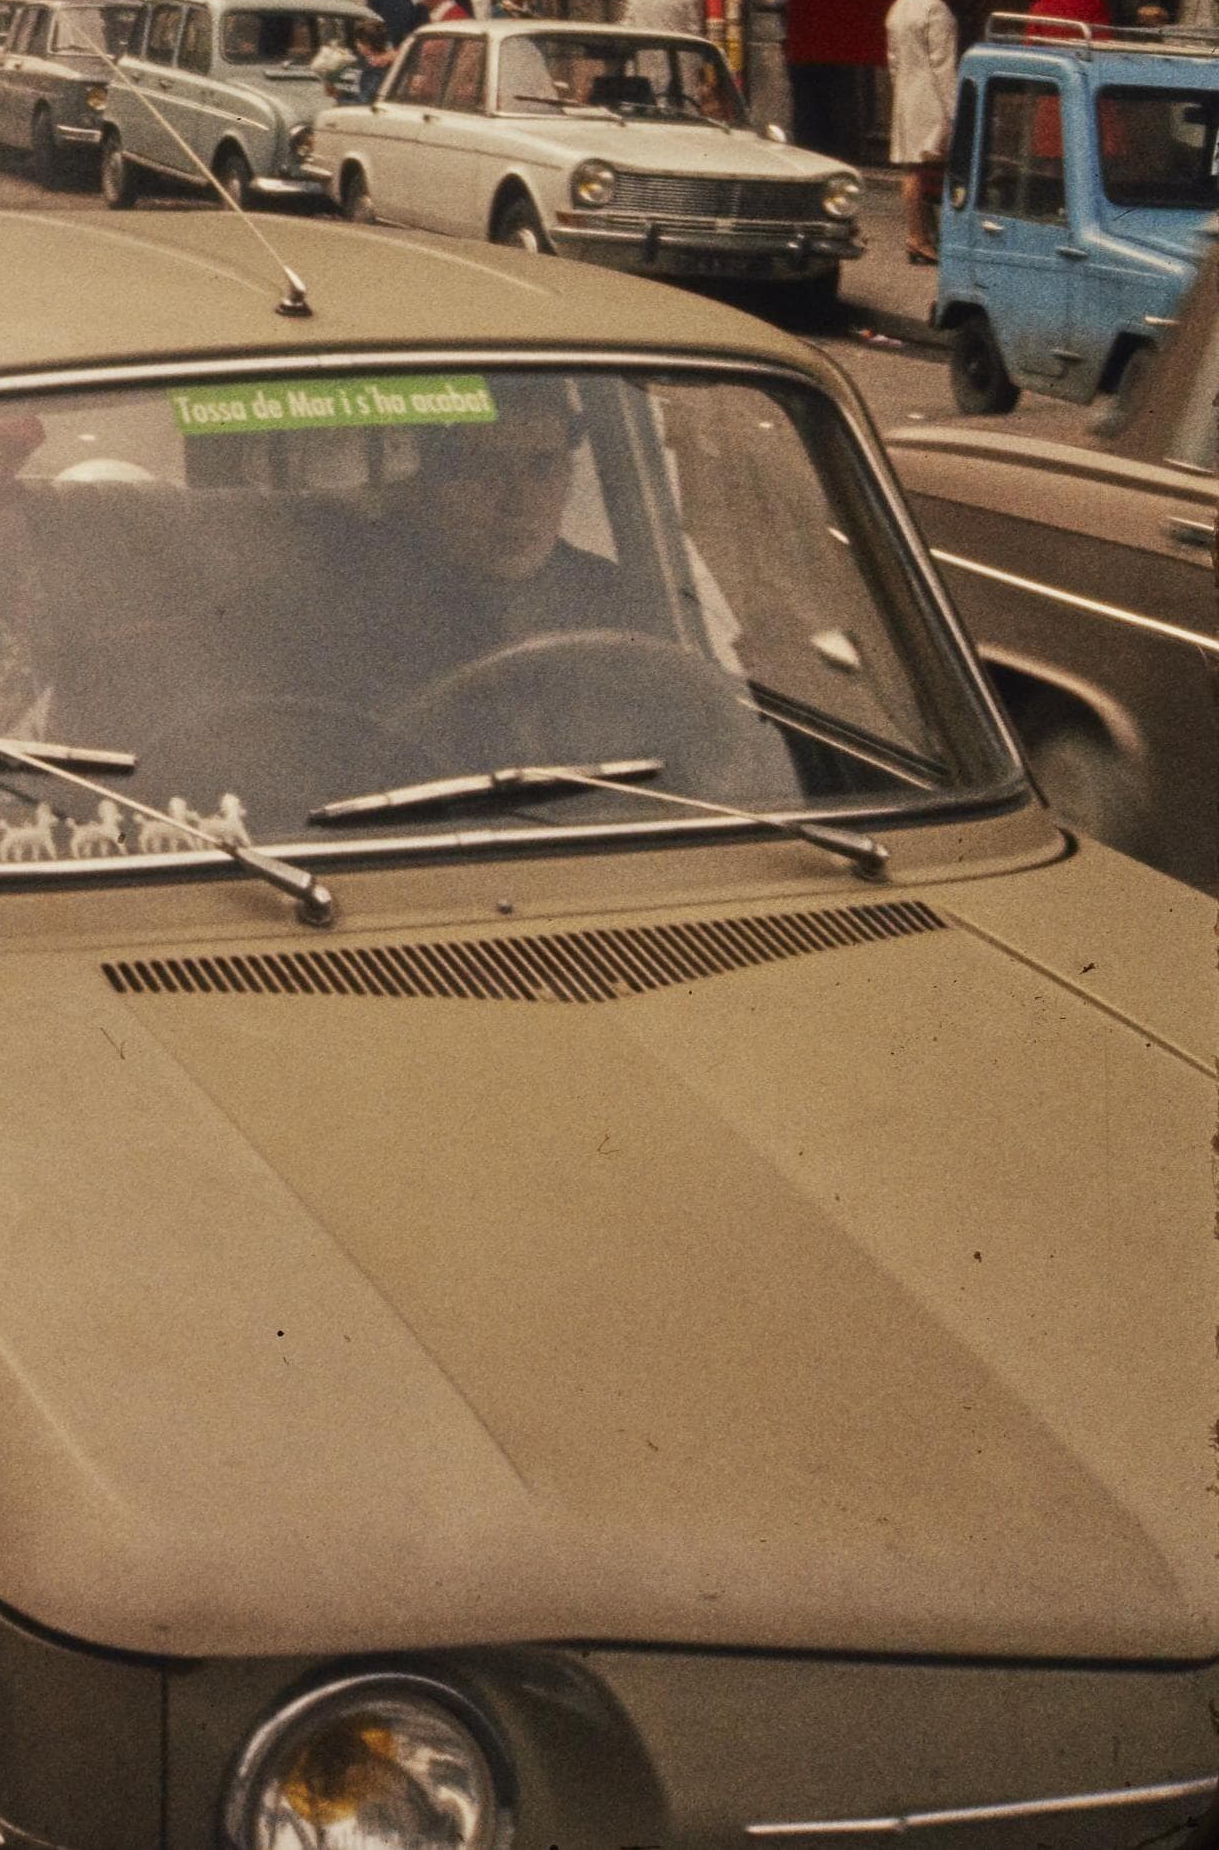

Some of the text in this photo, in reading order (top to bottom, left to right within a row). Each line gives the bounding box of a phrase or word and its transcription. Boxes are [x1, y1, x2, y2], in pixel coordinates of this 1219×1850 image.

[175, 395, 248, 423] Tossa
[253, 390, 284, 420] de
[286, 390, 336, 418] Mar
[339, 389, 352, 416] i
[410, 383, 492, 413] acabat
